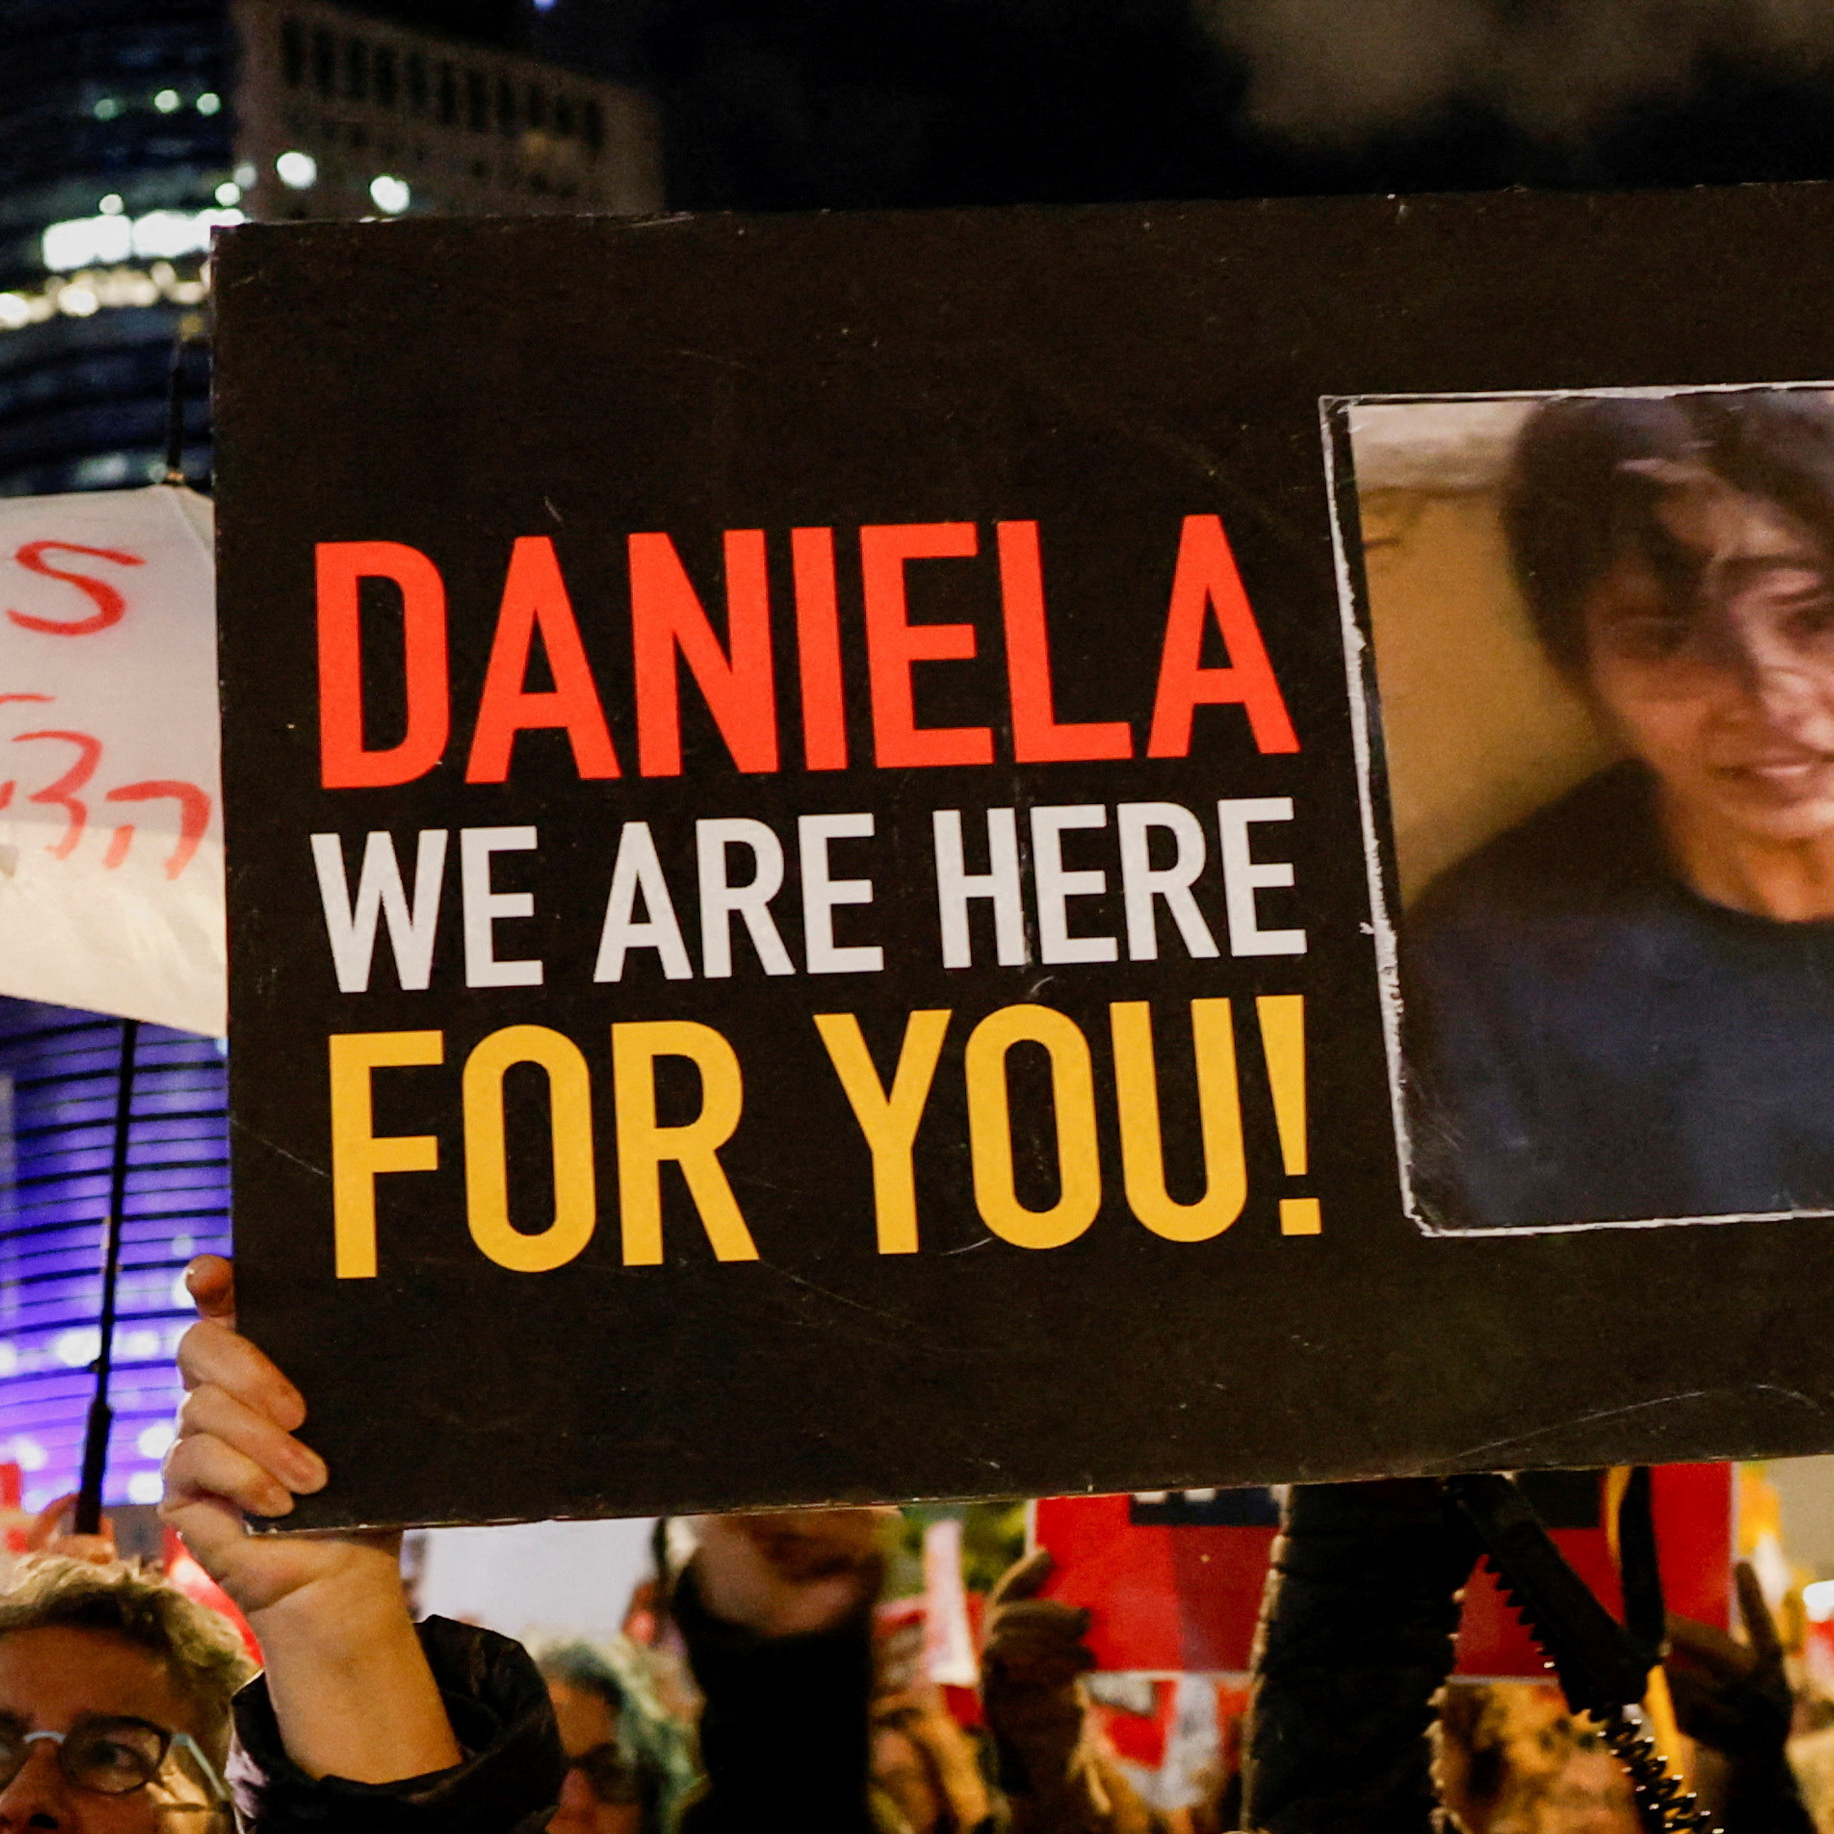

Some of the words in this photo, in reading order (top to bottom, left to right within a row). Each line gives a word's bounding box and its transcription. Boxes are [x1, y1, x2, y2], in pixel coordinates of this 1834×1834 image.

[315, 515, 1300, 788] DANIELA
[311, 827, 542, 992] WE
[594, 814, 883, 982] ARE
[934, 798, 1306, 968] HERE
[330, 1021, 759, 1278] FOR
[814, 995, 1321, 1254] YOU!
